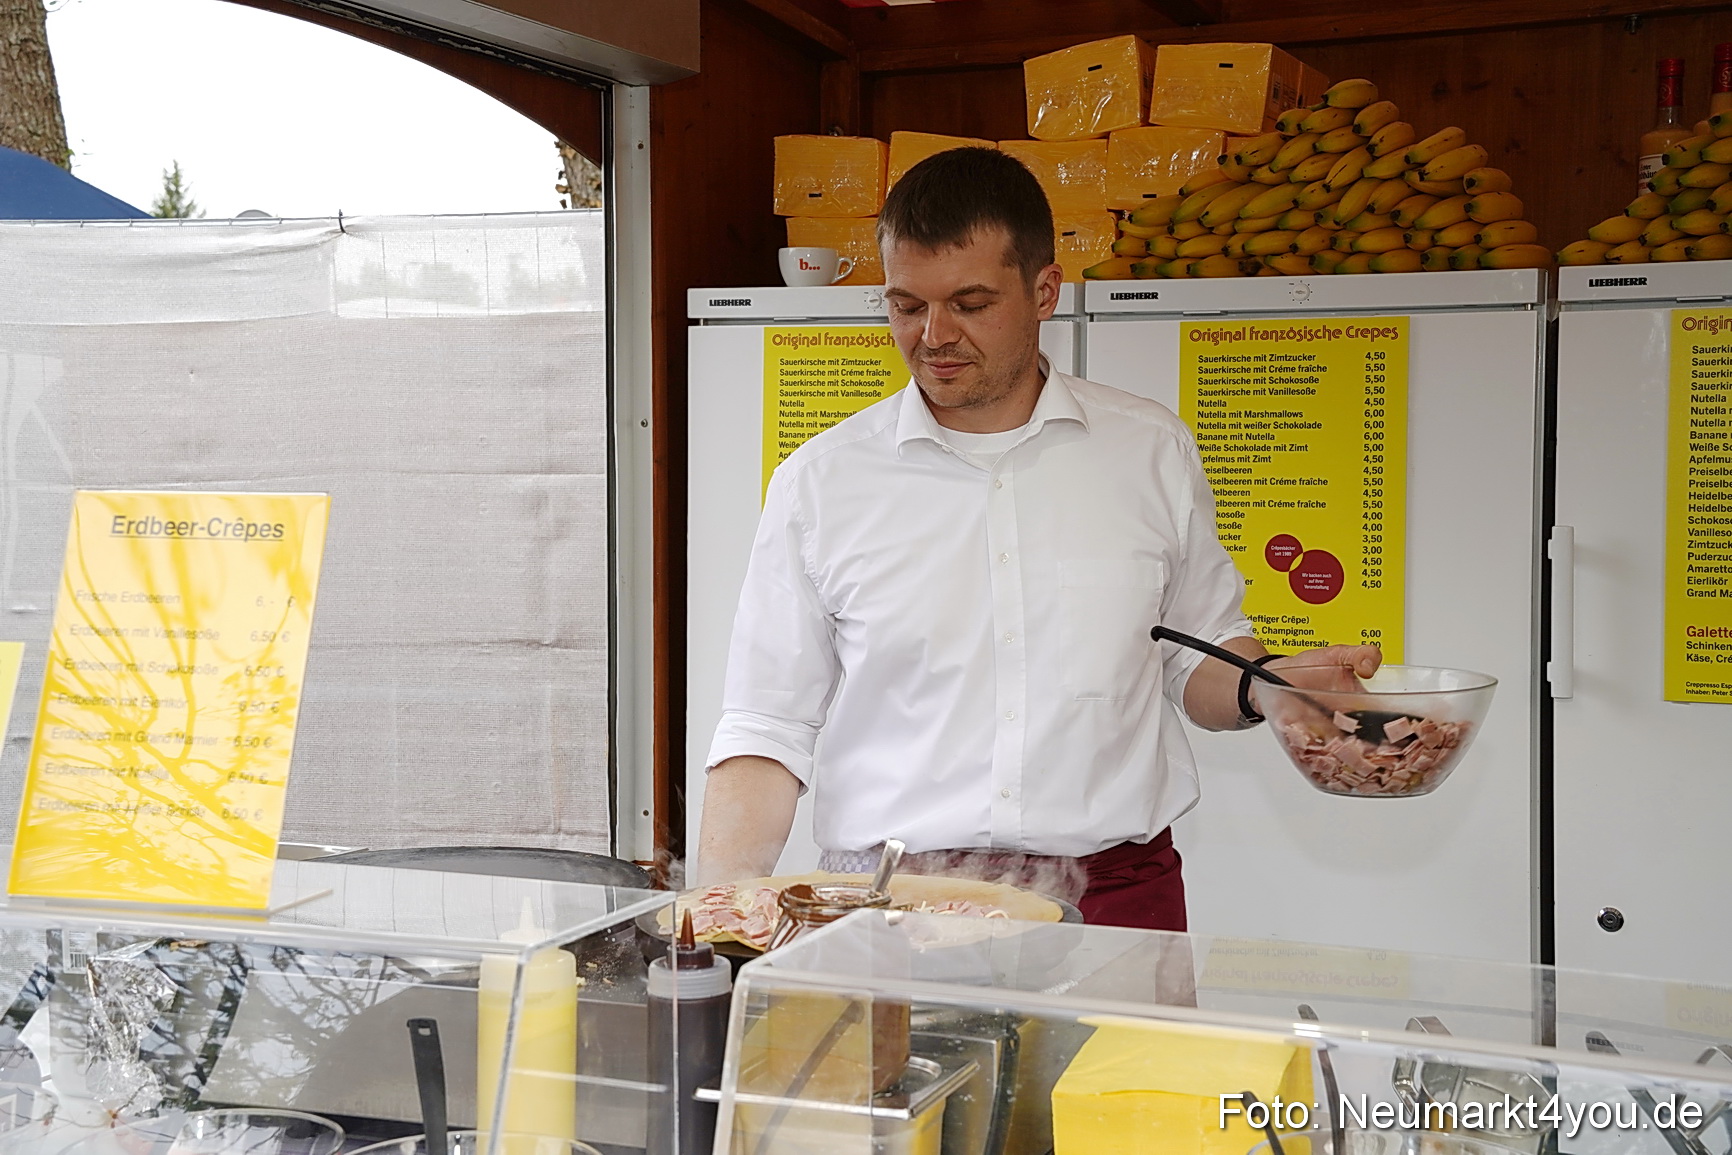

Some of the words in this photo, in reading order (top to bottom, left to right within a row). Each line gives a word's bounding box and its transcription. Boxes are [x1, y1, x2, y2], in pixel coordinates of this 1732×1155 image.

[1589, 277, 1647, 287] LIEBHERR
[1110, 292, 1158, 300] LIEBHERR
[1190, 327, 1246, 346] Original
[1346, 326, 1398, 342] Crepes
[772, 333, 821, 350] Original
[824, 332, 896, 347] französisch
[1198, 355, 1251, 363] Sauerkirsche
[1254, 354, 1267, 362] mit
[1365, 352, 1385, 361] 4,50
[1198, 366, 1251, 374] Sauerkirsche
[1269, 365, 1296, 373] Créme
[1366, 363, 1385, 372] 5,50
[1198, 377, 1251, 385] Sauerkirsche
[1269, 376, 1319, 384] Schokosoße
[1365, 375, 1385, 384] 5,50
[1198, 388, 1250, 396] Sauerkirsche
[1268, 387, 1316, 395] Vanillesoße
[1365, 386, 1385, 395] 5,50
[1365, 398, 1384, 407] 4,50
[1691, 394, 1726, 402] Nutella
[1244, 410, 1303, 418] Marshmallows
[1364, 409, 1384, 418] 6,00
[1691, 406, 1726, 415] Nutella
[1273, 421, 1322, 429] Schokolade
[1364, 421, 1384, 429] 6,00
[1690, 419, 1725, 427] Nutella
[1364, 432, 1384, 441] 6,00
[1690, 431, 1727, 439] Banane
[1364, 444, 1384, 453] 5,00
[1690, 443, 1719, 451] Weiße
[1202, 455, 1234, 463] pfelmus
[1253, 455, 1271, 463] Zimt
[1364, 455, 1383, 464] 4,50
[1204, 466, 1252, 474] eiselbeeren
[1363, 466, 1383, 475] 4,50
[1363, 478, 1383, 487] 5,50
[1363, 489, 1383, 498] 4,50
[1268, 500, 1295, 508] Créme
[1297, 500, 1326, 508] fraîche
[1363, 501, 1383, 509] 5,50
[1362, 512, 1382, 521] 4,00
[111, 515, 284, 540] Erdbeer-Crêpes
[1362, 523, 1382, 532] 4,00
[1362, 535, 1382, 543] 3,50
[1362, 546, 1382, 555] 3,00
[1362, 558, 1382, 566] 4,50
[1362, 569, 1382, 578] 4,50
[1362, 580, 1381, 589] 4,50
[1687, 577, 1728, 585] Eierlikör
[76, 590, 117, 602] Frische
[122, 591, 180, 604] Erdbeeren
[1687, 589, 1716, 597] Grand
[1248, 614, 1278, 624] deftiger
[71, 624, 129, 637] Erdbeeren
[132, 626, 149, 638] mit
[1262, 626, 1314, 636] Champignon
[1361, 629, 1381, 638] 6,00
[1282, 639, 1329, 647] Kräutersalz
[1686, 653, 1713, 663] Käse,
[65, 659, 123, 671] Erdbeeren
[59, 693, 117, 706] Erdbeeren
[52, 727, 111, 740] Erdbeeren
